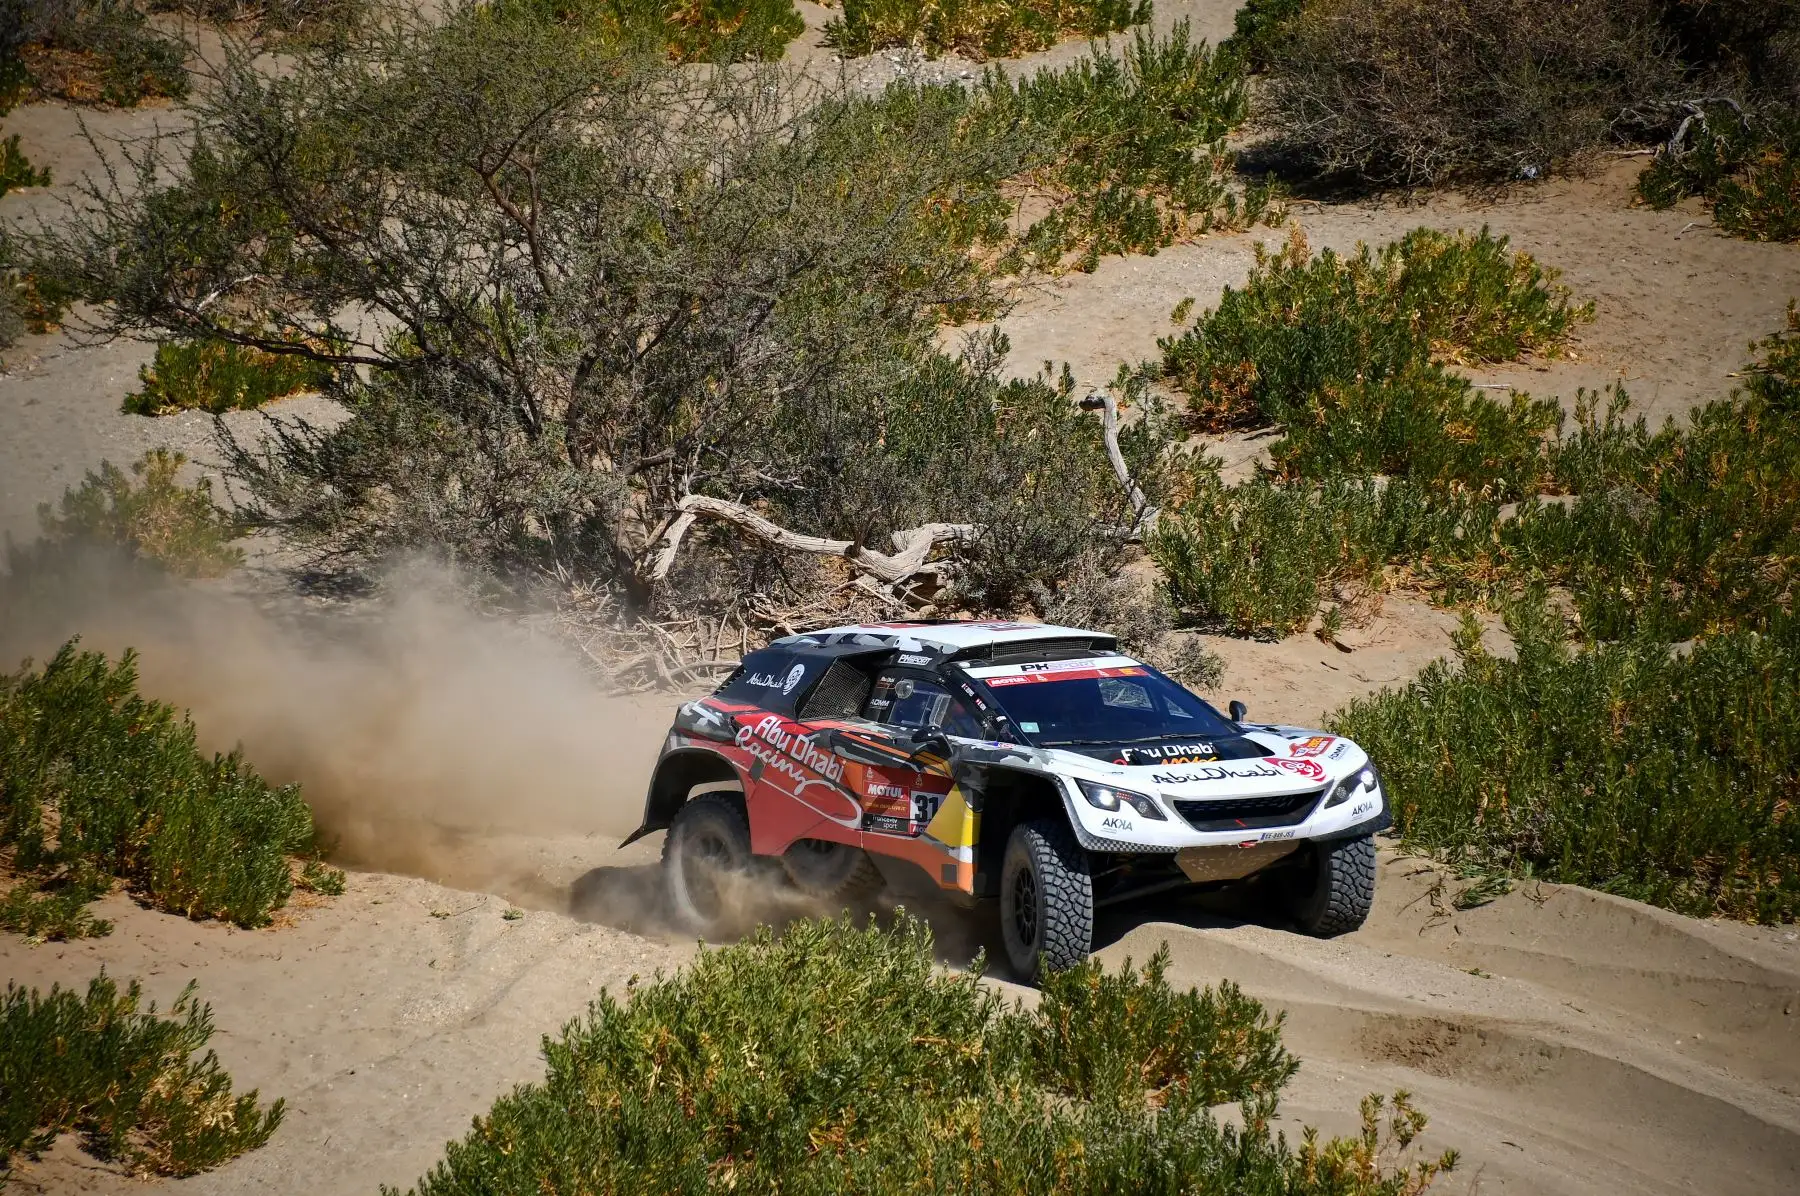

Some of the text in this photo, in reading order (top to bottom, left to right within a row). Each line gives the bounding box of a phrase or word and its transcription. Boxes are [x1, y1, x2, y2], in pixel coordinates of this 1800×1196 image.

[991, 677, 1027, 685] MOTUL
[754, 716, 846, 783] Abu Dhabi
[867, 784, 904, 799] MOTUL
[1101, 817, 1133, 831] AKKA
